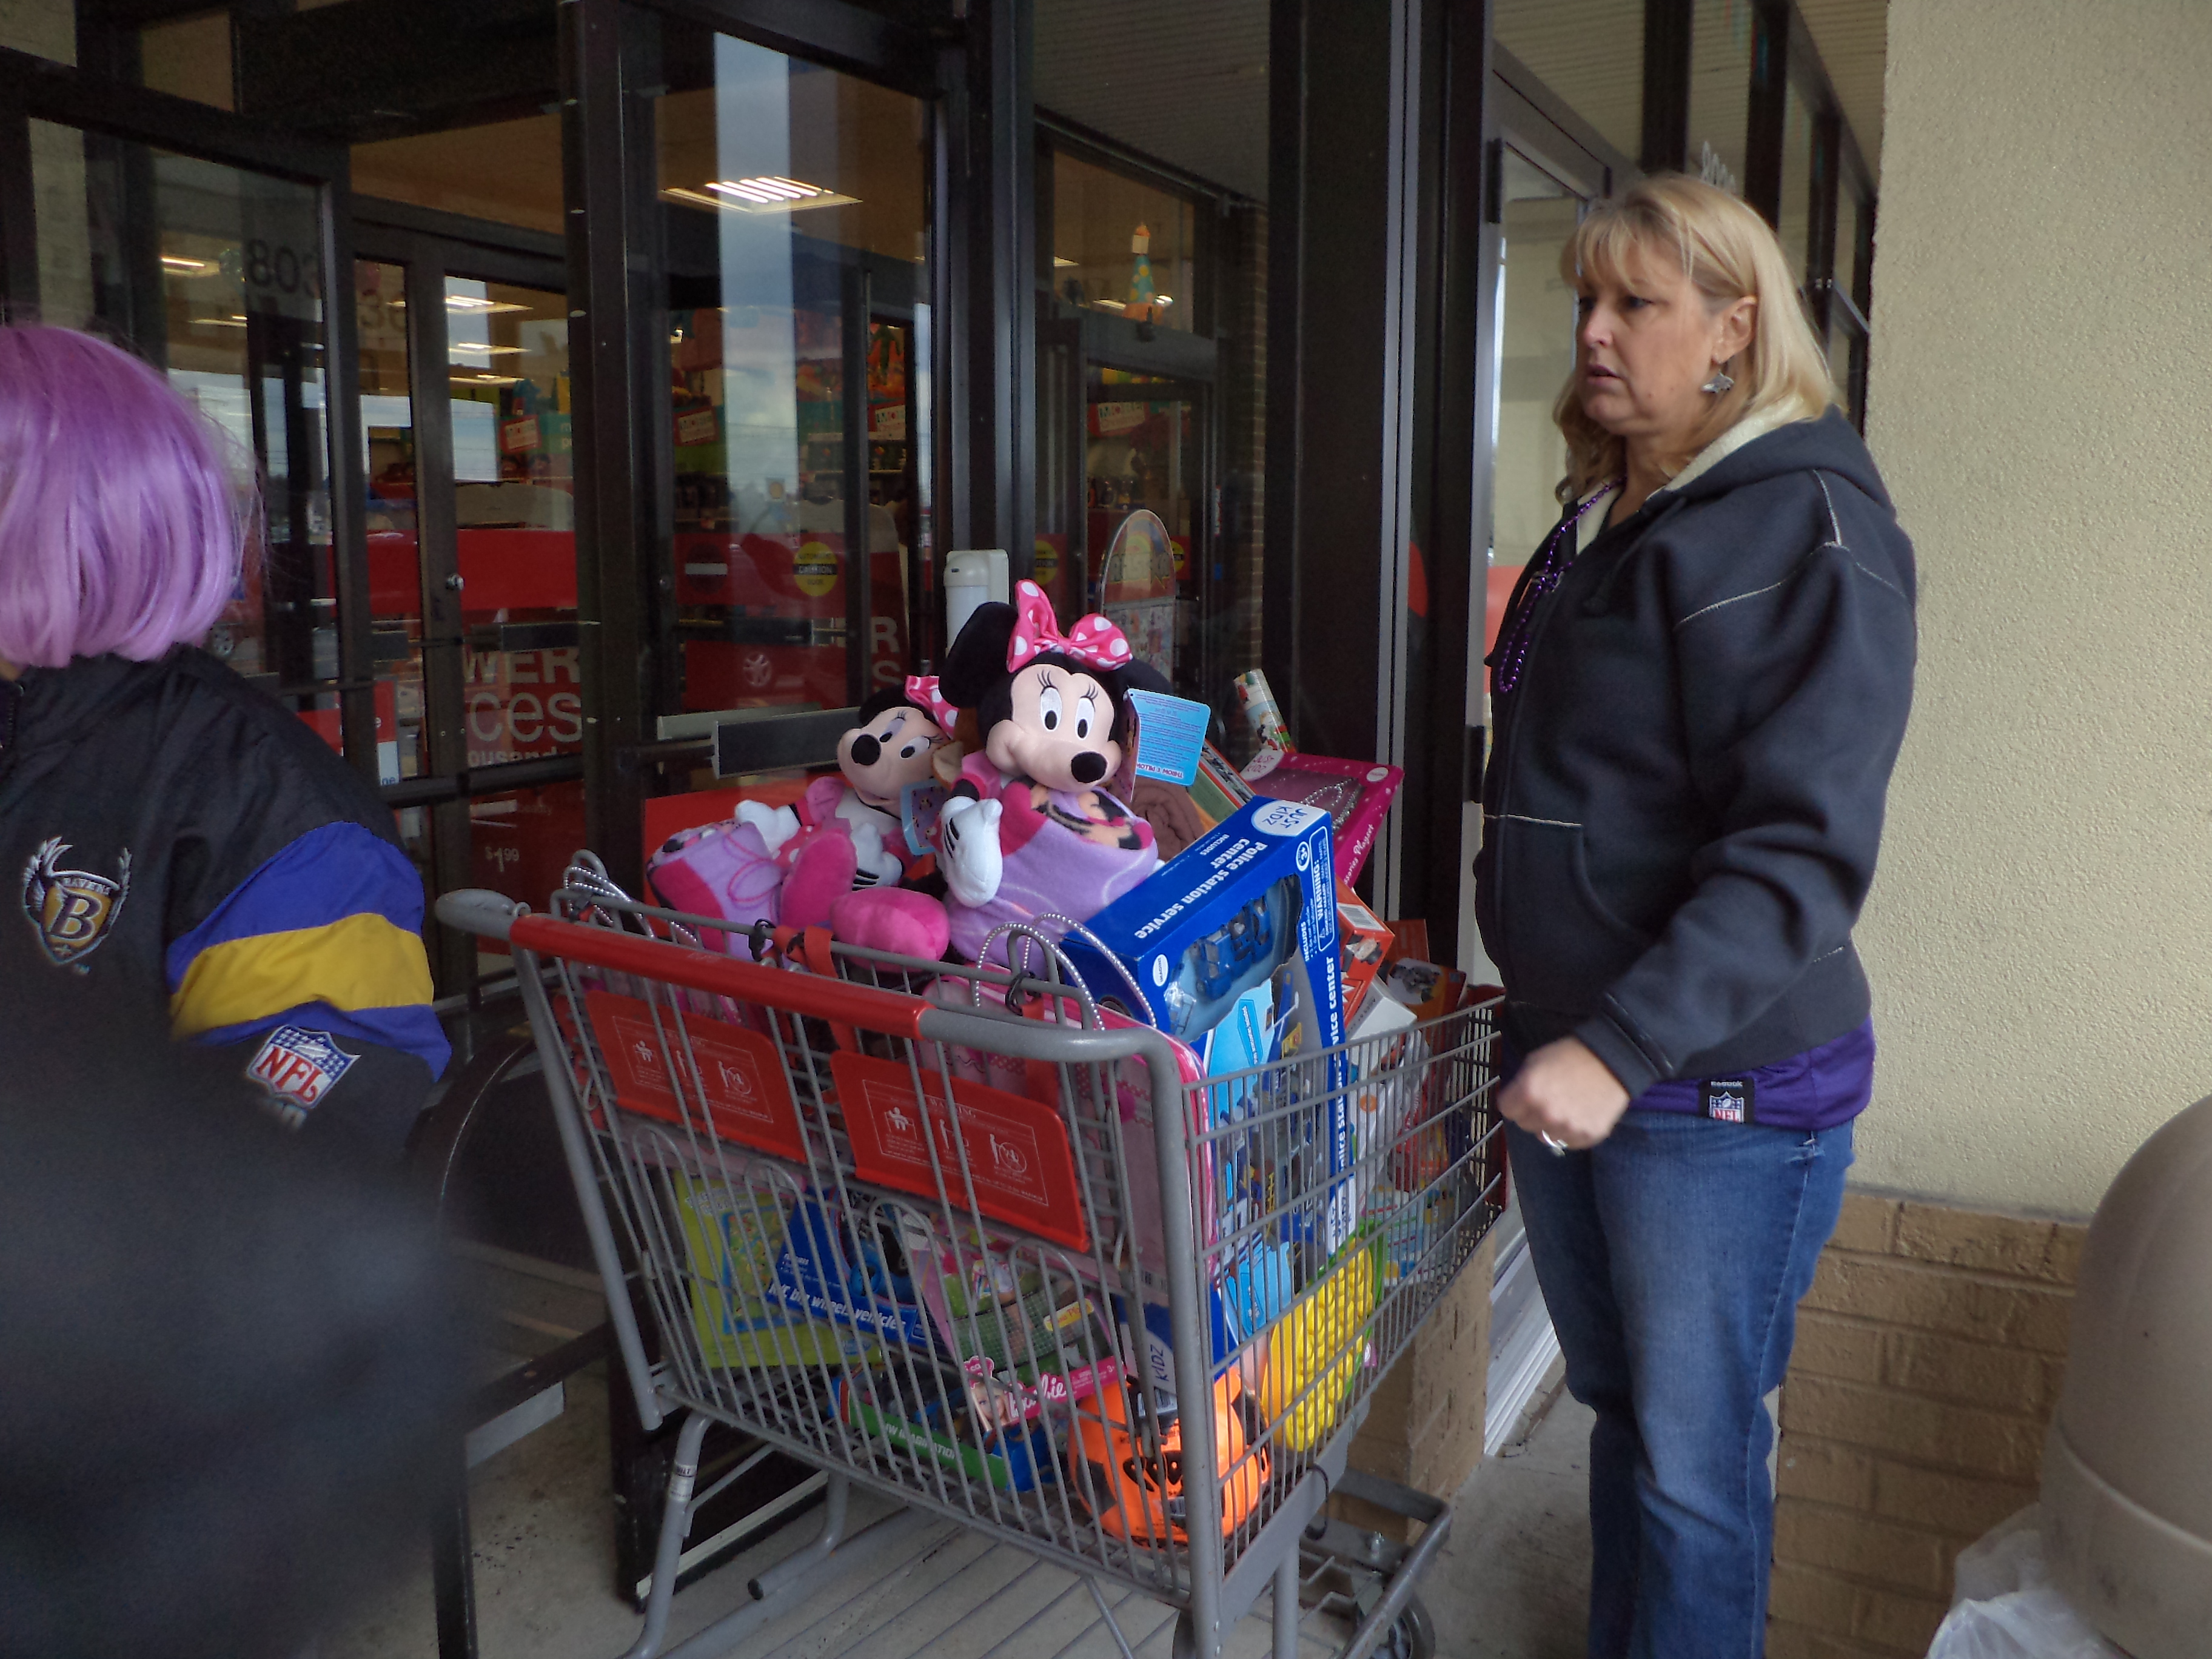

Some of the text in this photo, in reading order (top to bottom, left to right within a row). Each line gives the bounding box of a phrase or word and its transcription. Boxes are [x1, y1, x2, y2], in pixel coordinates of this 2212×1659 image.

[1262, 805, 1292, 826] KIDZ
[1280, 808, 1309, 828] JUST
[1199, 834, 1230, 856] INCLUDES
[1210, 838, 1250, 869] center
[1226, 841, 1268, 870] Police
[1353, 823, 1374, 855] Playset
[1181, 869, 1230, 904] station
[1313, 859, 1324, 920] WARNING:
[47, 884, 102, 941] B
[1134, 902, 1184, 939] service
[1300, 921, 1309, 961] INCLUDES
[1326, 956, 1338, 1010] center
[257, 1046, 323, 1102] NFL
[1714, 1109, 1740, 1122] NFL
[1156, 1343, 1170, 1383] KIDZ
